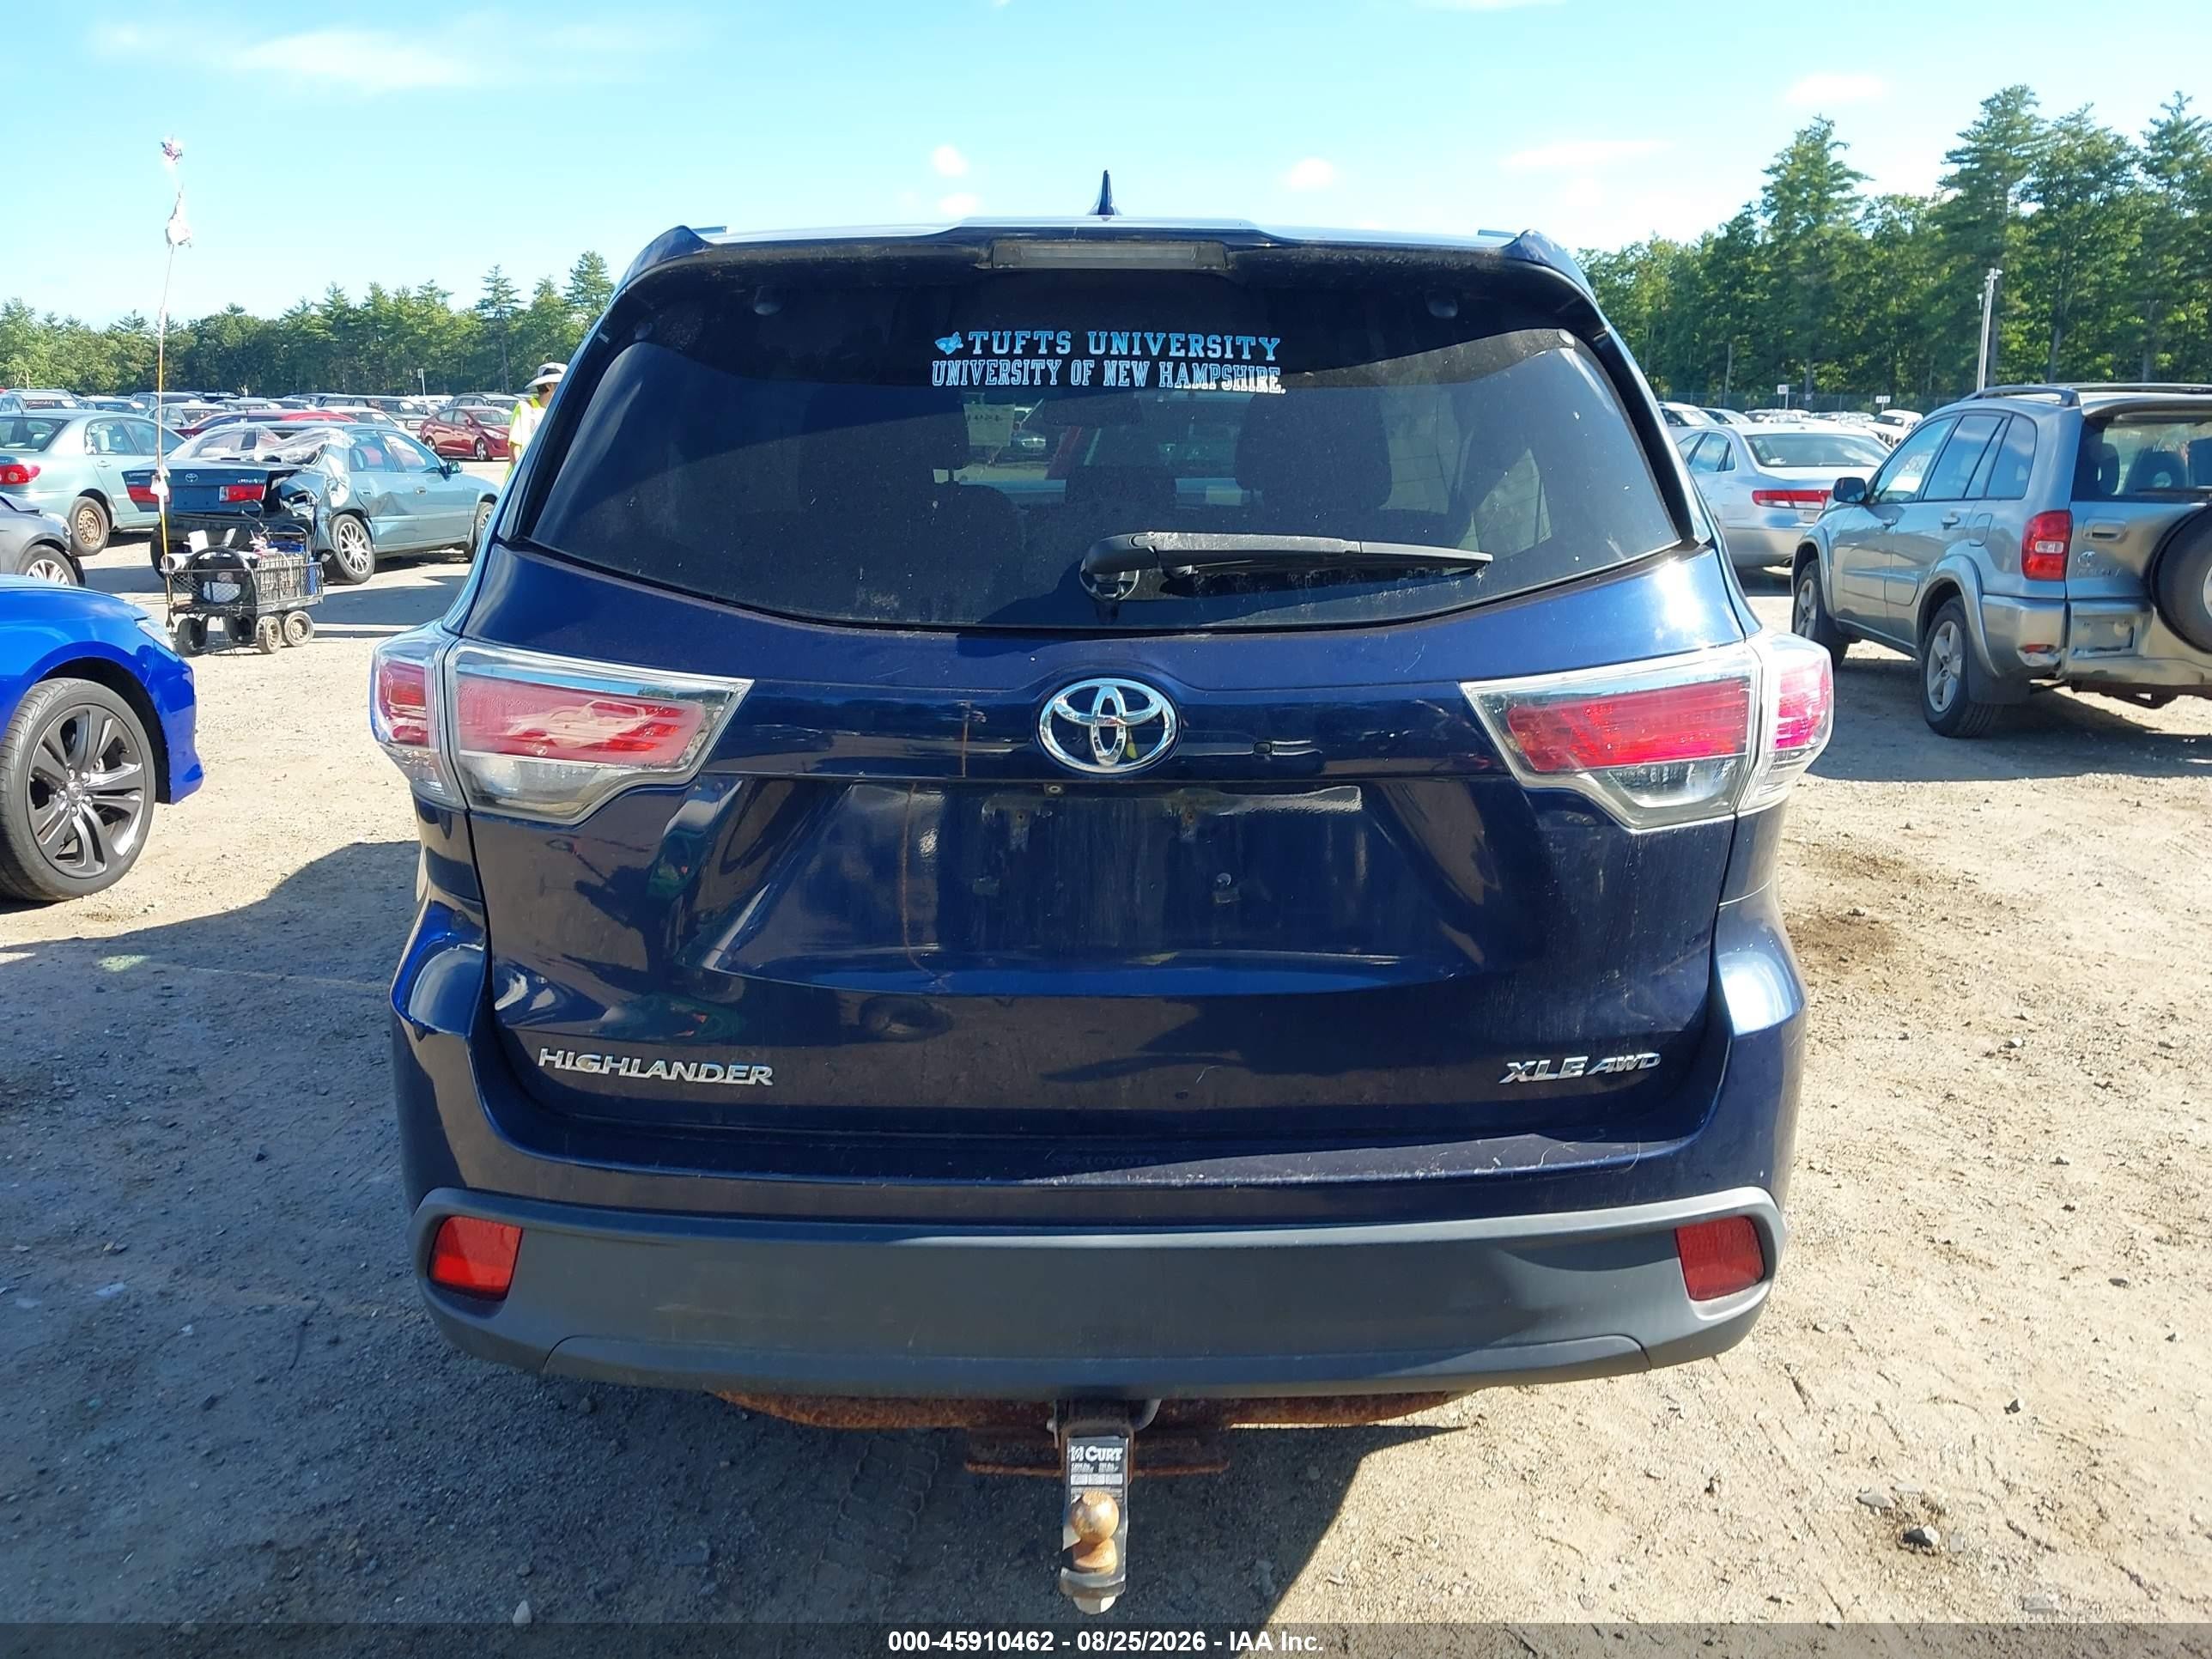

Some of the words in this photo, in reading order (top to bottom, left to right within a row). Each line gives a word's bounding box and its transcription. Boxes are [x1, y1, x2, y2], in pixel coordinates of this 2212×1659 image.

[969, 331, 1072, 355] TUFTS
[1089, 331, 1280, 361] UNIVERSITY
[932, 359, 1062, 386] UNIVERSITY
[1071, 360, 1095, 386] OF
[1103, 361, 1150, 387] NEW
[538, 1048, 773, 1085] HIGHLANDER
[1498, 1056, 1589, 1084] XLE
[1586, 1052, 1661, 1075] AWD
[1084, 1155, 1158, 1165] TOYOTA
[1085, 1445, 1123, 1462] CURT
